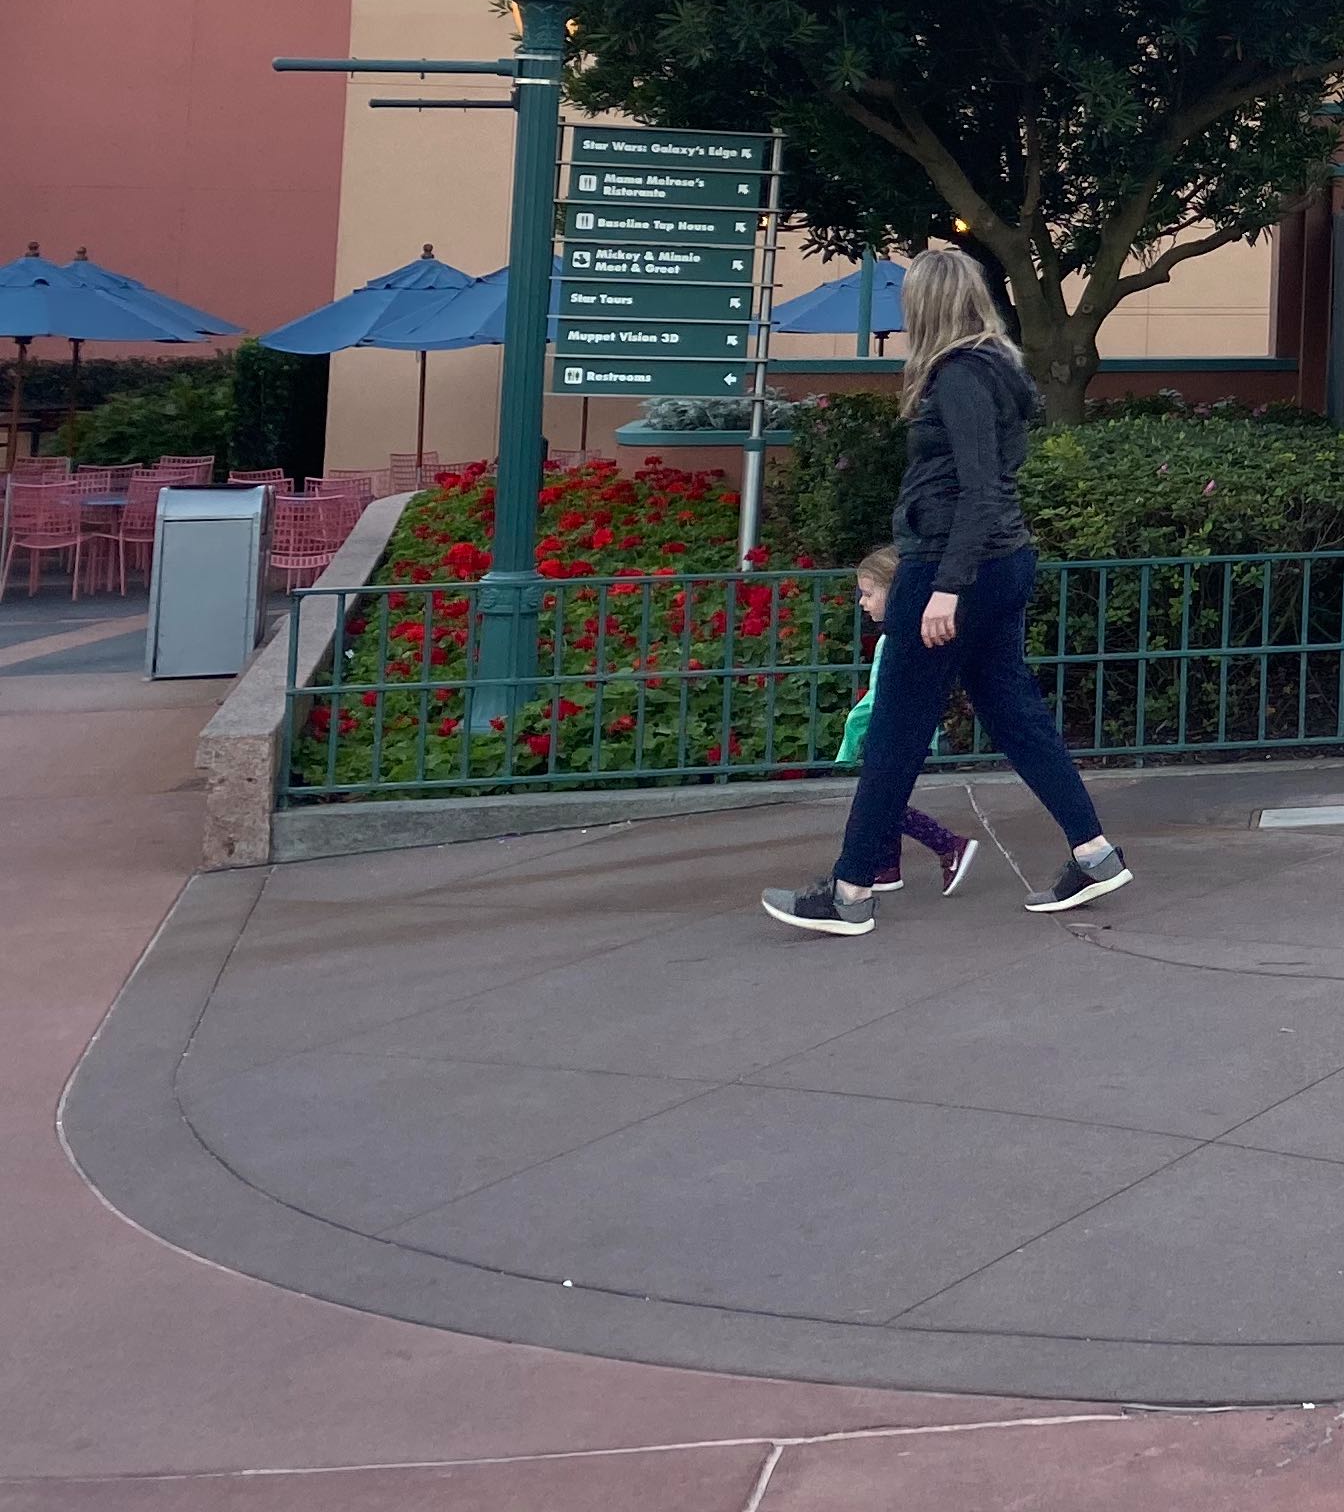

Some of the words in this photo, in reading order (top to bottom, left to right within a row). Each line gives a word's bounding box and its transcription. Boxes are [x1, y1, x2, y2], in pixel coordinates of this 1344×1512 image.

[583, 140, 608, 150] Star
[612, 142, 647, 153] Wars:
[651, 144, 704, 156] Galaxy's
[708, 147, 738, 159] Edge
[604, 174, 642, 185] Mama
[646, 176, 704, 187] Melrose's
[603, 186, 666, 198] Ristorante
[598, 218, 649, 229] Baseline
[654, 220, 674, 231] Tap
[678, 222, 714, 231] House
[596, 250, 641, 262] Mickey
[644, 251, 654, 260] &
[658, 252, 700, 263] Minnie
[595, 262, 627, 272] Meet
[631, 264, 640, 273] &
[645, 265, 680, 274] Greet
[571, 293, 597, 303] Star
[600, 294, 632, 304] Tours
[568, 331, 615, 343] Muppet
[620, 332, 657, 342] Vision
[661, 334, 679, 343] 3D
[586, 372, 652, 382] Restrooms
